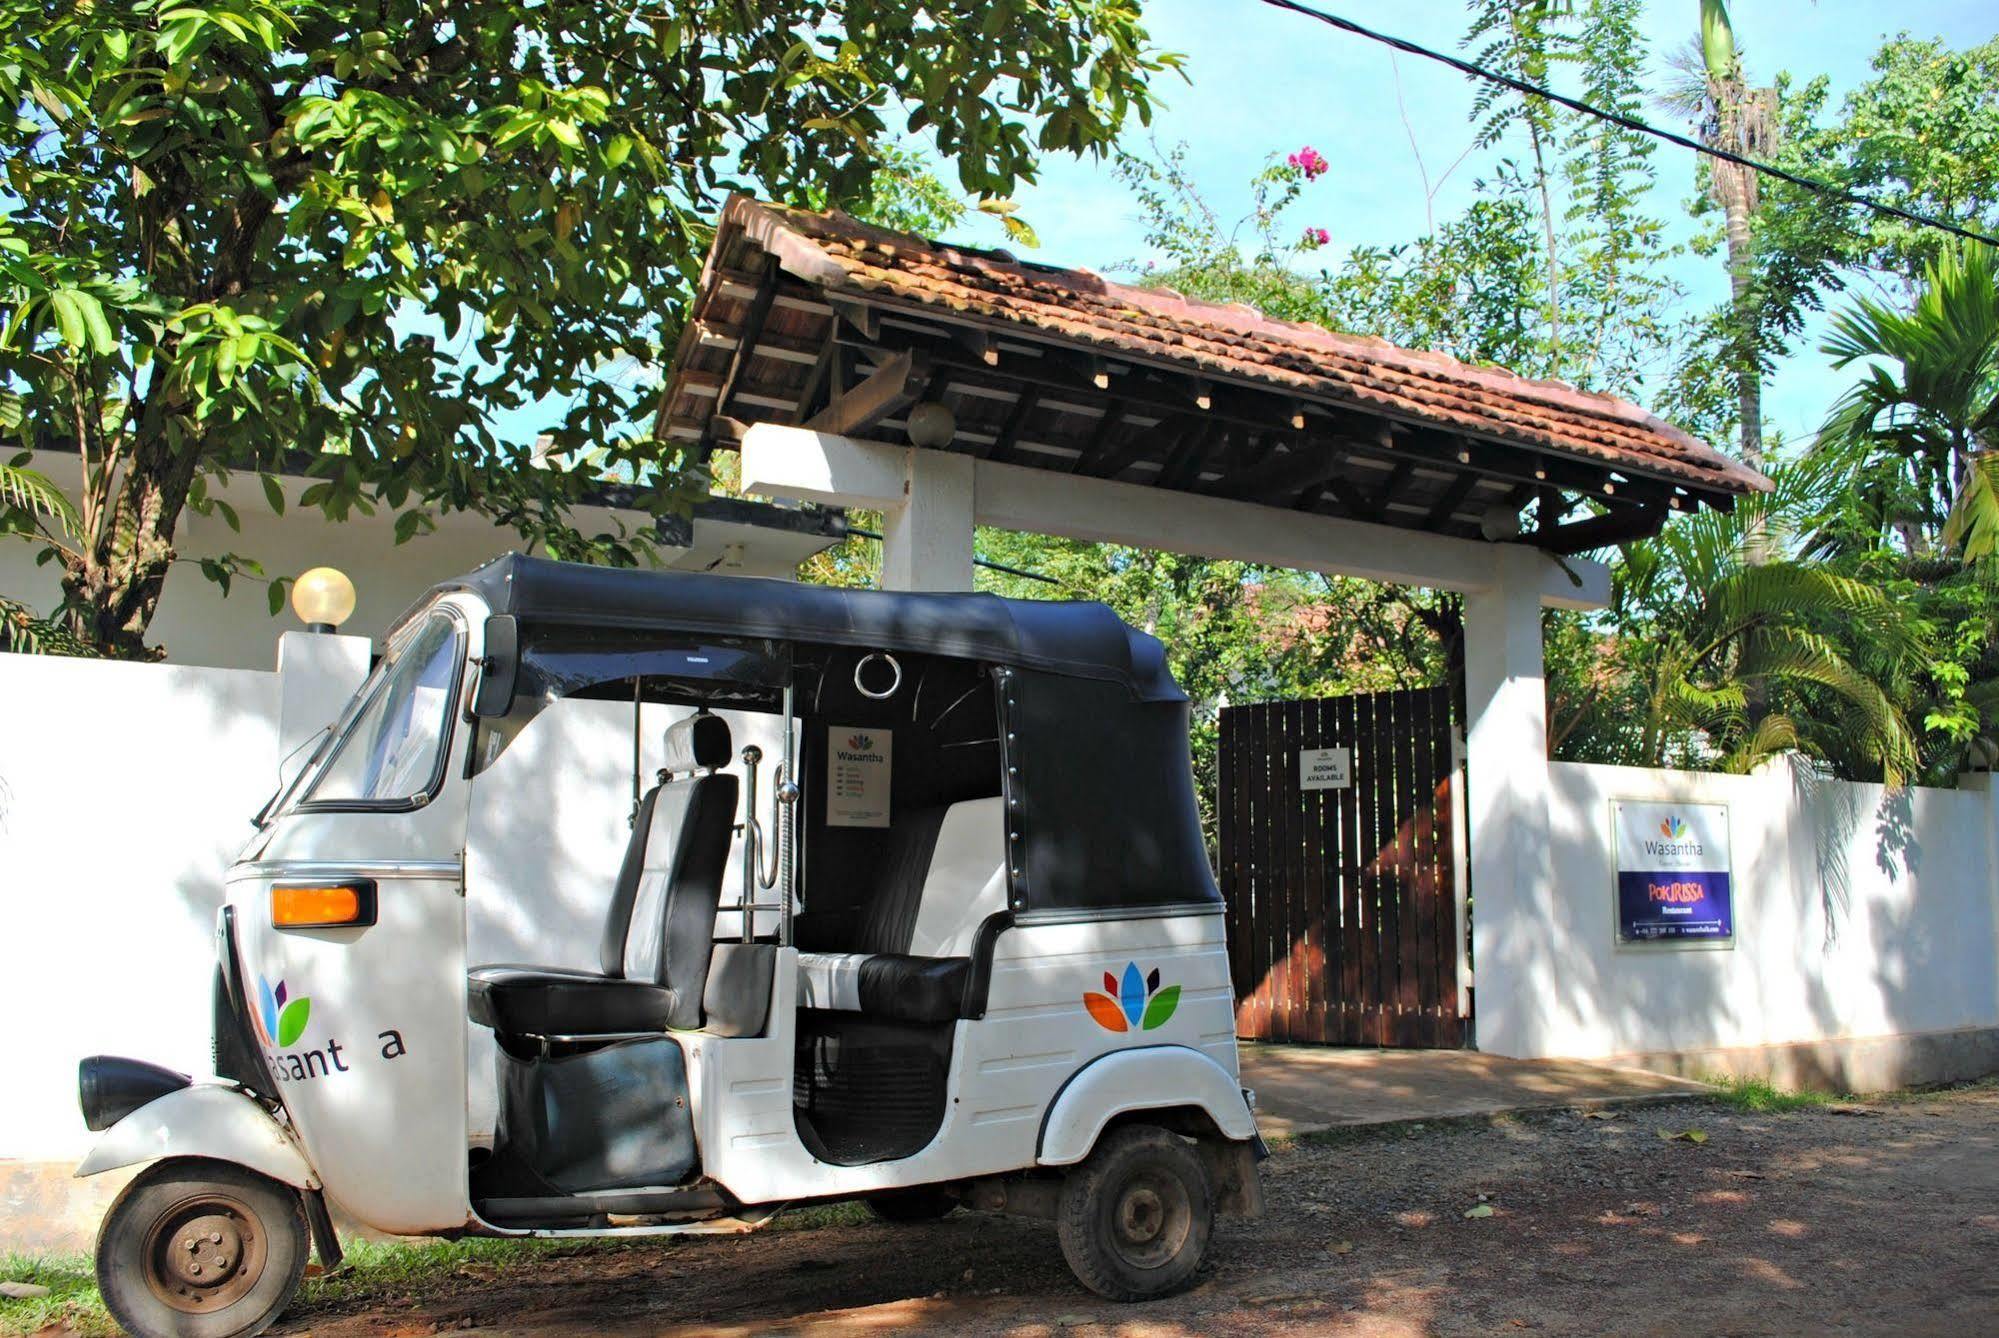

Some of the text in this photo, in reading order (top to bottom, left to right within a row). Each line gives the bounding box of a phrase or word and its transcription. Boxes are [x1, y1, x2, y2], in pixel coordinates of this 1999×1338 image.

[837, 751, 884, 763] Wasantha
[1313, 764, 1337, 772] ROOMS
[1307, 773, 1344, 782] AVAILABLE
[1645, 840, 1703, 856] Wasantha
